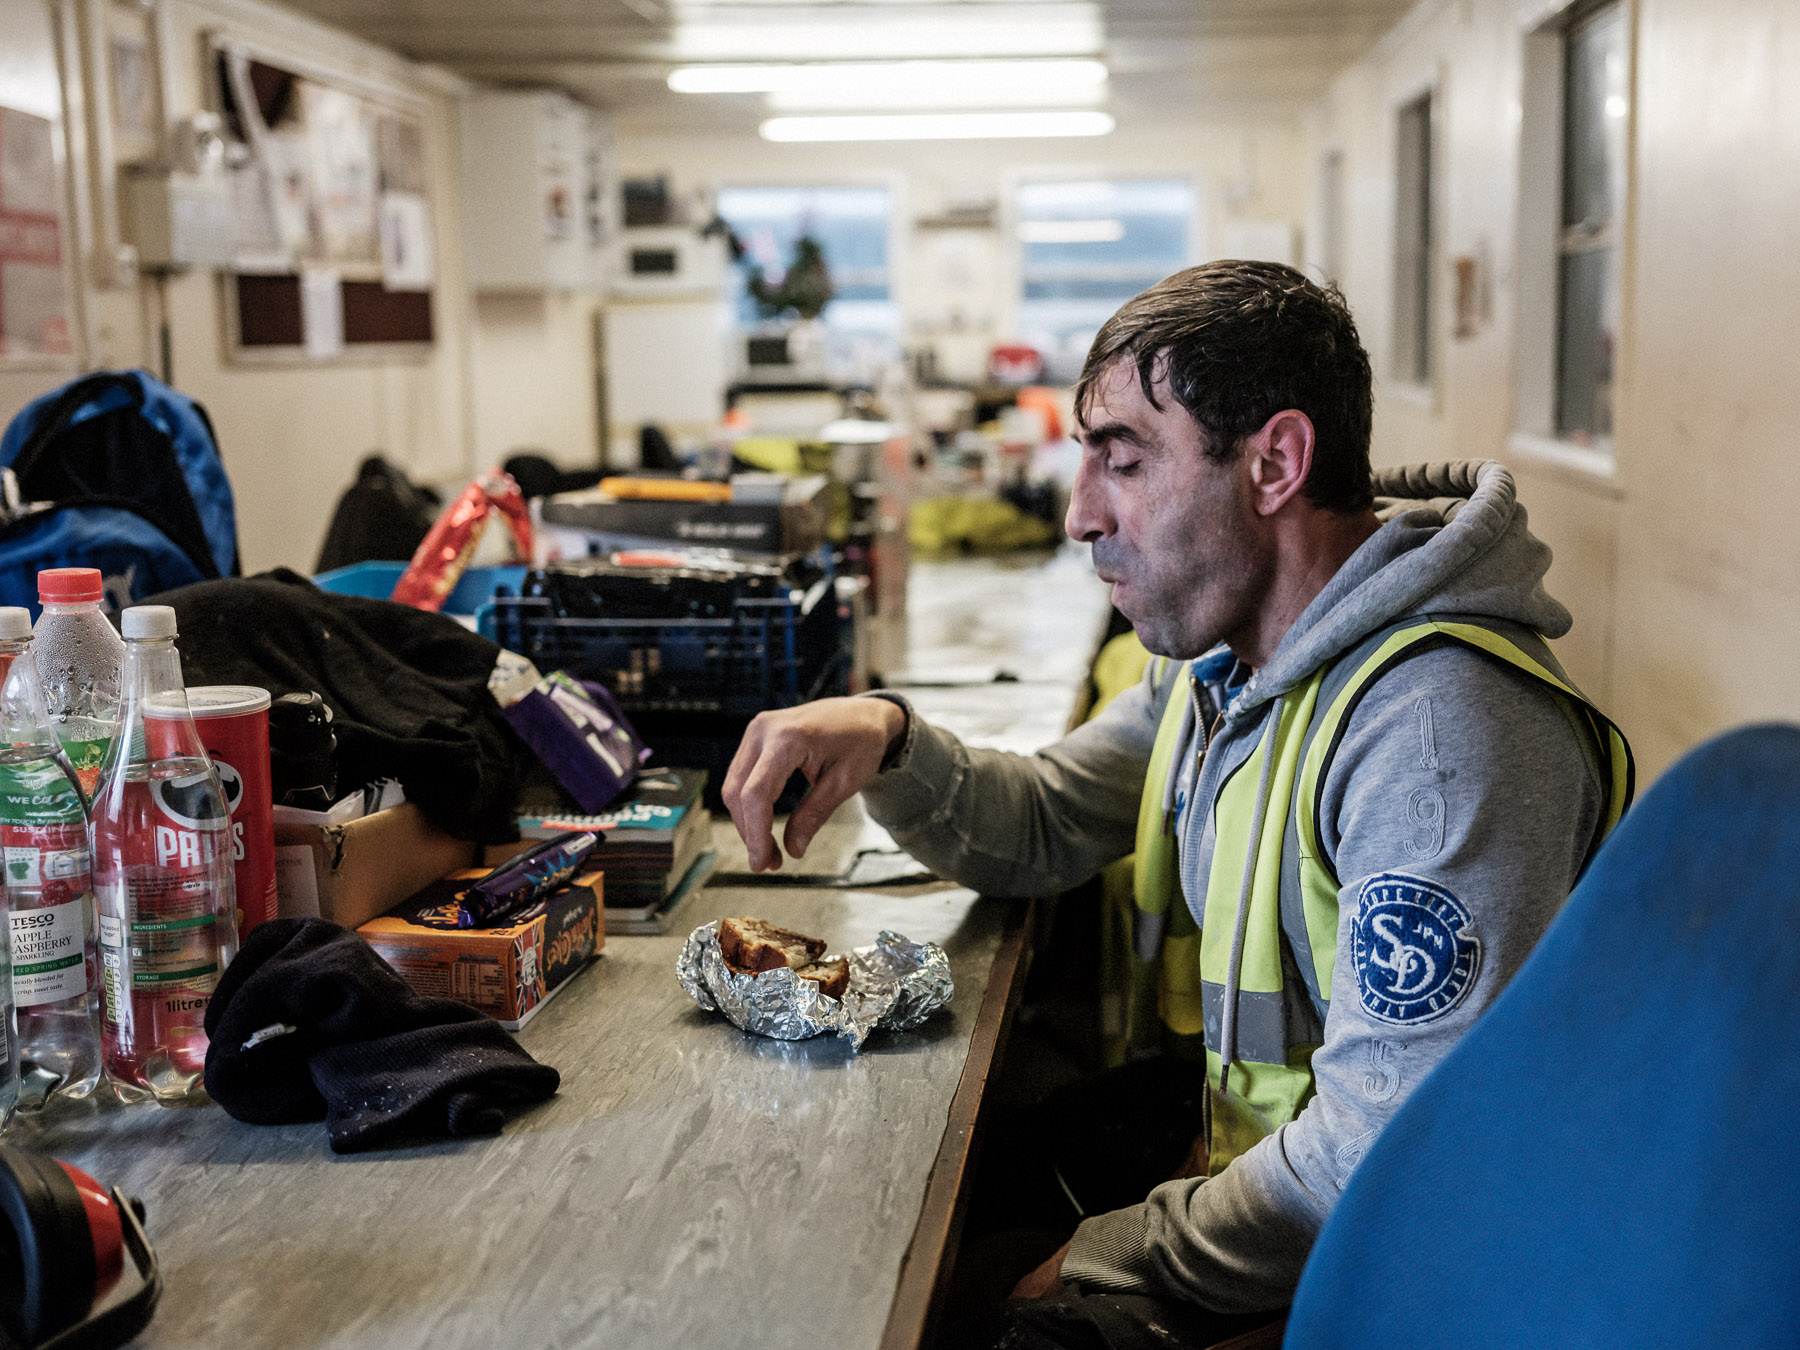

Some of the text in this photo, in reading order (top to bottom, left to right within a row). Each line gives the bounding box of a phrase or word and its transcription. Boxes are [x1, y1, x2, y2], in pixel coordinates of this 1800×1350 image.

[7, 795, 30, 804] WE
[11, 913, 55, 927] TESCO
[14, 930, 52, 943] APPLE
[1412, 922, 1443, 950] JPN
[11, 935, 72, 954] ASPBERRY
[16, 950, 55, 961] SPARKLING
[32, 962, 58, 972] SPRING
[1428, 953, 1470, 1011] TOKYO
